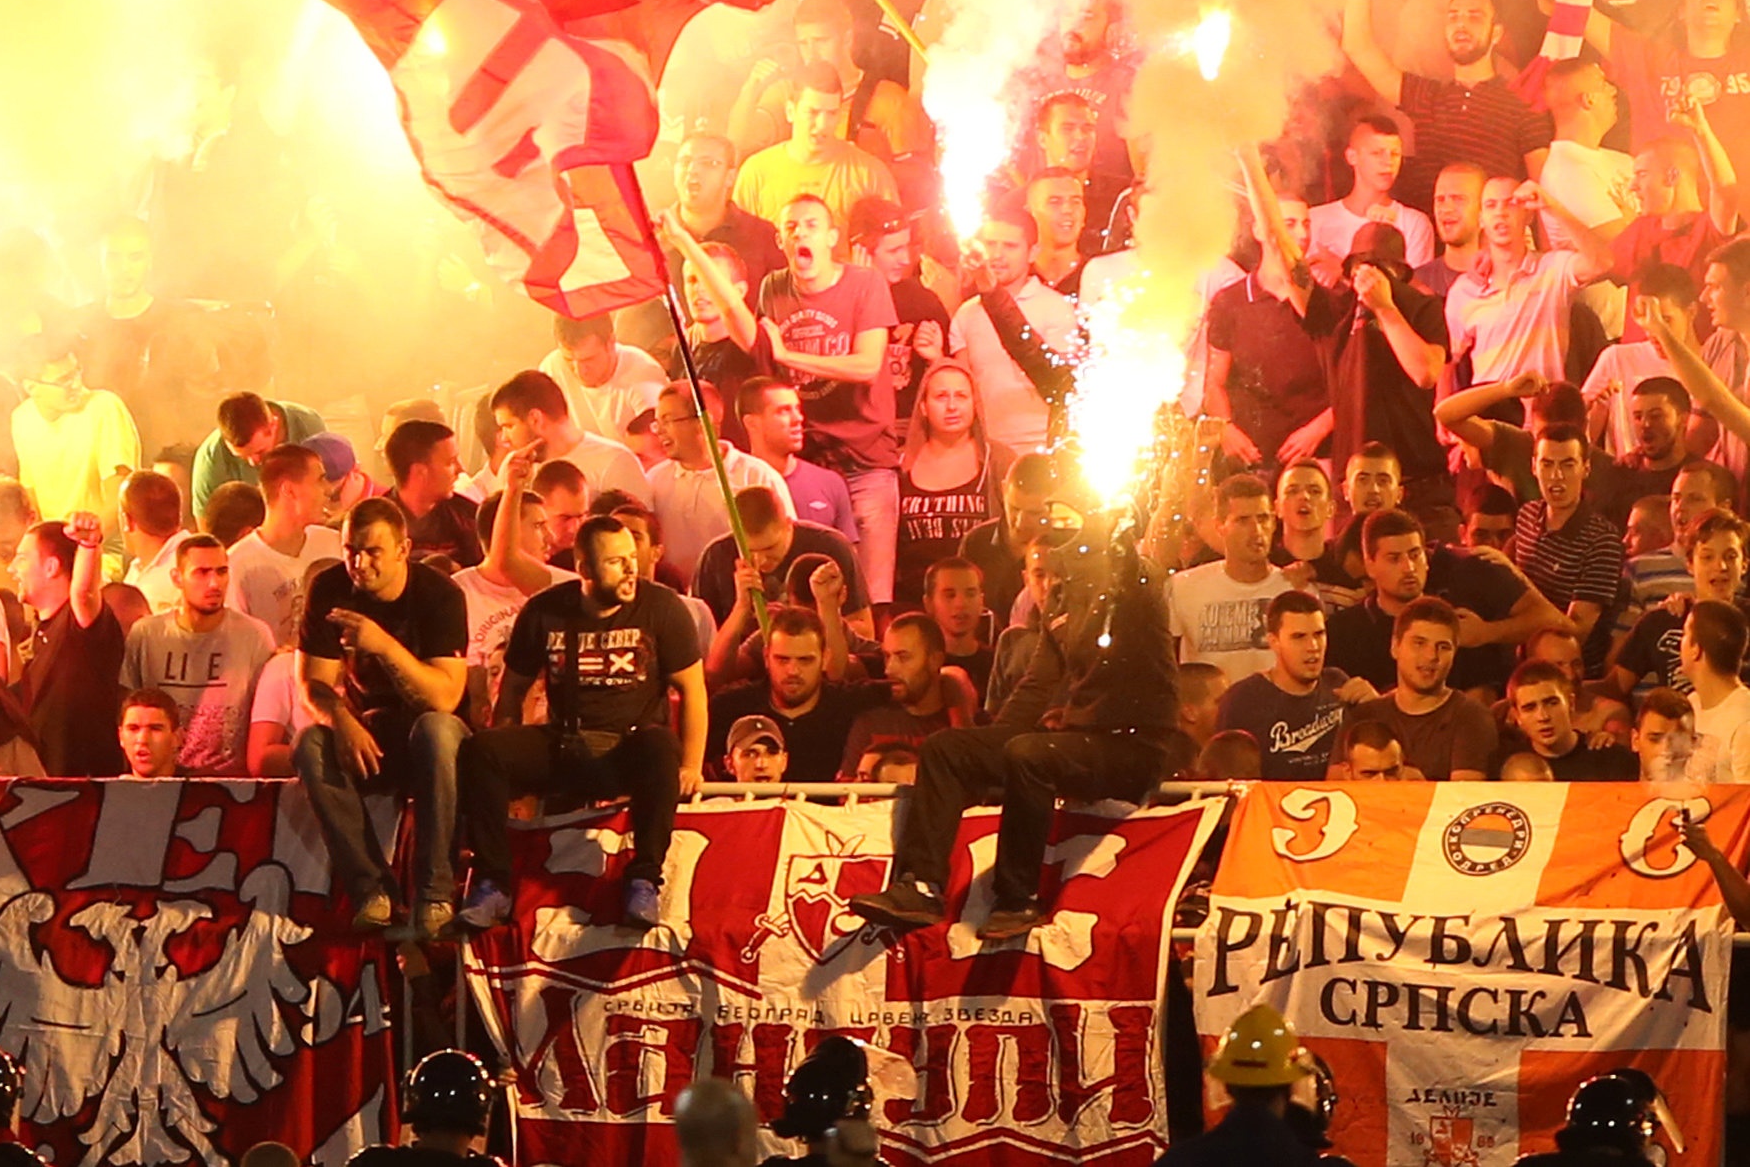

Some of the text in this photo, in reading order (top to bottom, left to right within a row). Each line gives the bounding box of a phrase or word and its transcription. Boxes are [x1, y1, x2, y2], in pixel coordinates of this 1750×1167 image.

[474, 603, 525, 643] ORIGINA
[1269, 707, 1344, 753] Broadway
[1207, 899, 1713, 1014] РЕПУБЛИКА
[943, 1007, 1034, 1025] ЗВЕЗДА
[1320, 977, 1593, 1038] СРПСКА
[1405, 1088, 1498, 1107] ДЕЛИЈЕ
